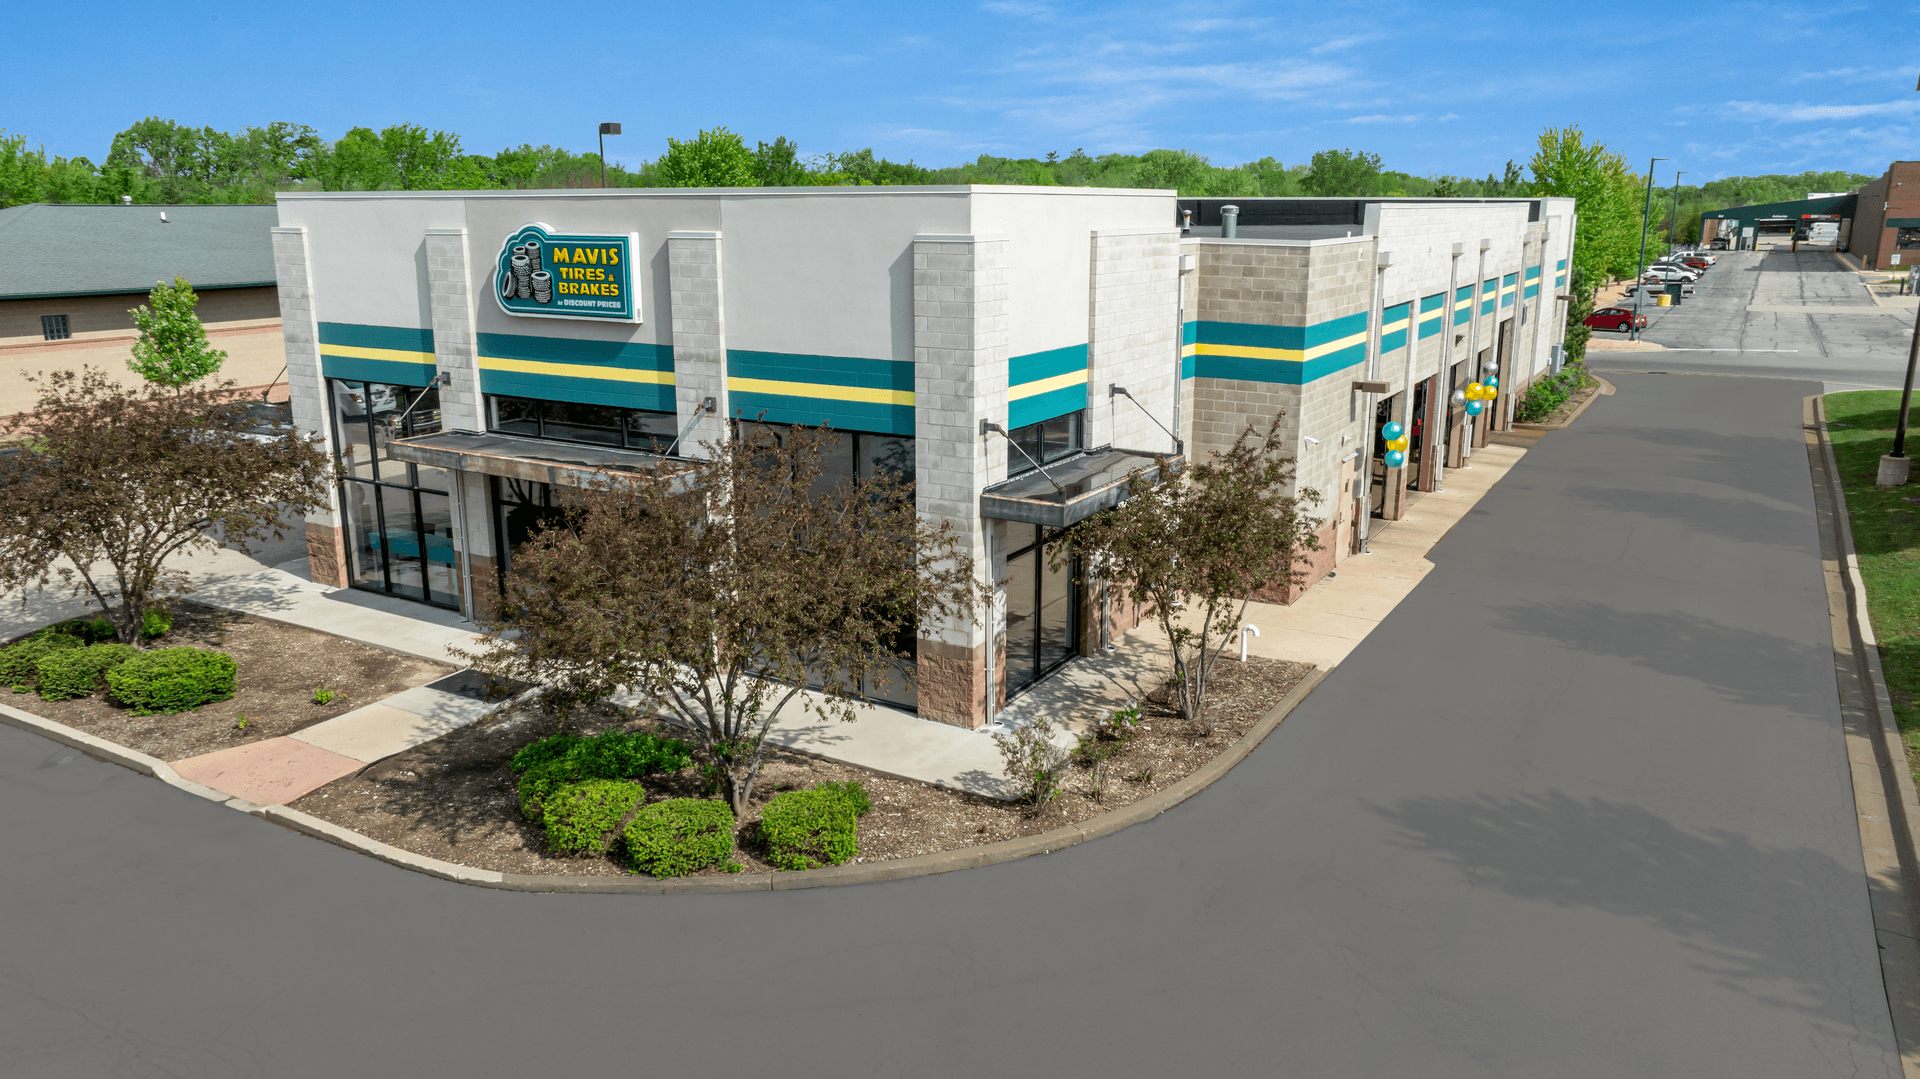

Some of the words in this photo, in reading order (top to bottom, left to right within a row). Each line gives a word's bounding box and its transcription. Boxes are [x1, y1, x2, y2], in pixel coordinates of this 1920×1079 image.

[553, 247, 619, 266] MAVIS
[559, 267, 606, 281] TIRES
[608, 273, 615, 282] &
[558, 282, 620, 297] BRAKES
[564, 299, 596, 307] DISCOUNT
[597, 300, 621, 308] PRICES
